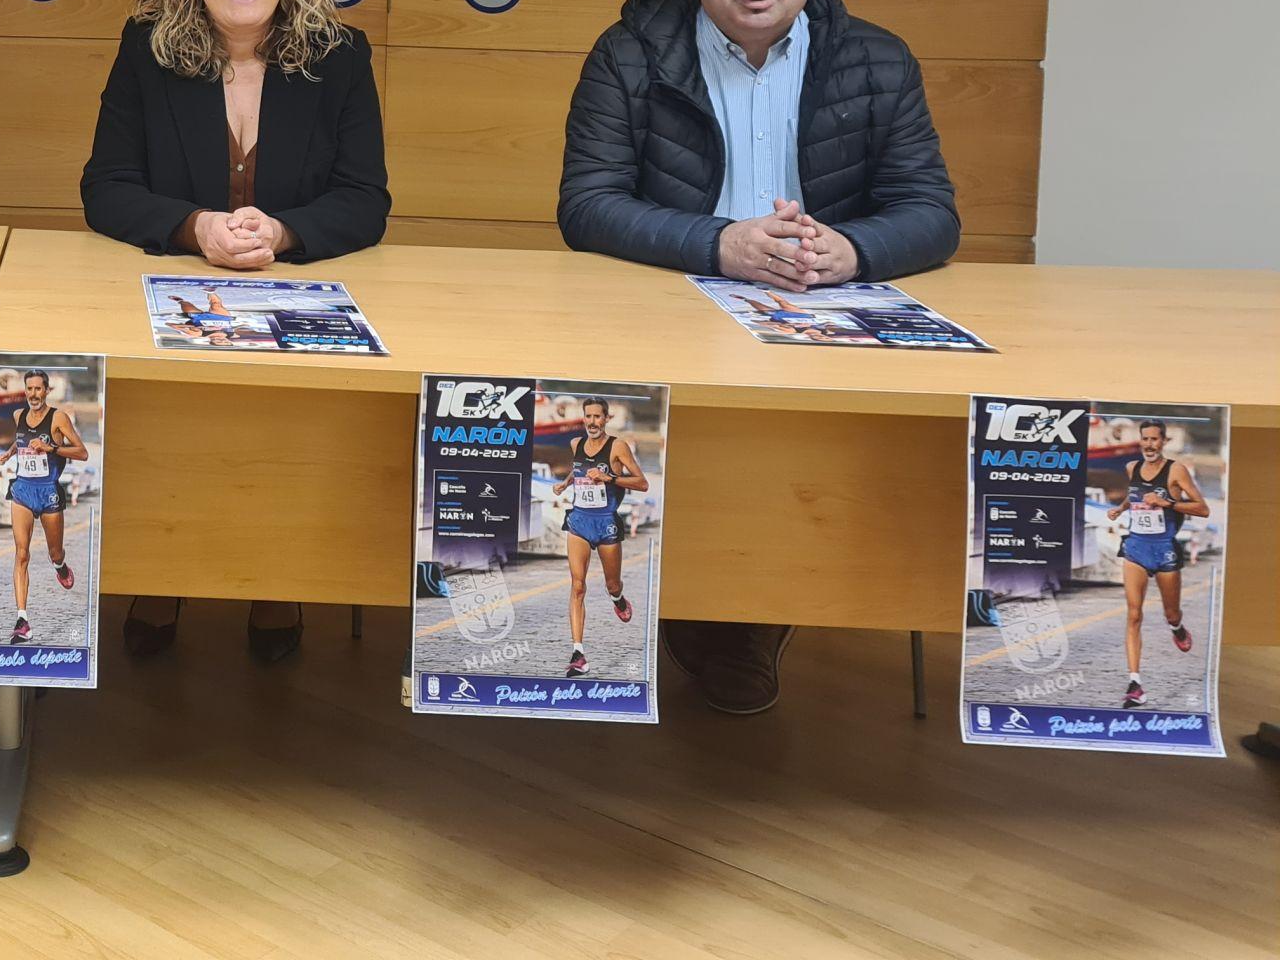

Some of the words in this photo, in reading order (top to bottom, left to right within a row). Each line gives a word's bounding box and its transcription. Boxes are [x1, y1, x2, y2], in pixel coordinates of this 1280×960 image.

[432, 422, 527, 446] NARÓN
[440, 448, 517, 458] 09-04-2023
[981, 445, 1081, 469] NARÓN
[24, 461, 36, 472] 49
[990, 472, 1070, 483] 09-04-2023
[582, 491, 594, 502] 49
[1138, 516, 1152, 527] 49
[30, 648, 82, 668] deporte
[495, 684, 547, 705] Paixón
[551, 683, 583, 704] polo
[587, 682, 641, 703] deporte
[1048, 716, 1105, 736] Paixón
[1108, 715, 1142, 737] polo
[1146, 714, 1203, 736] deporte
